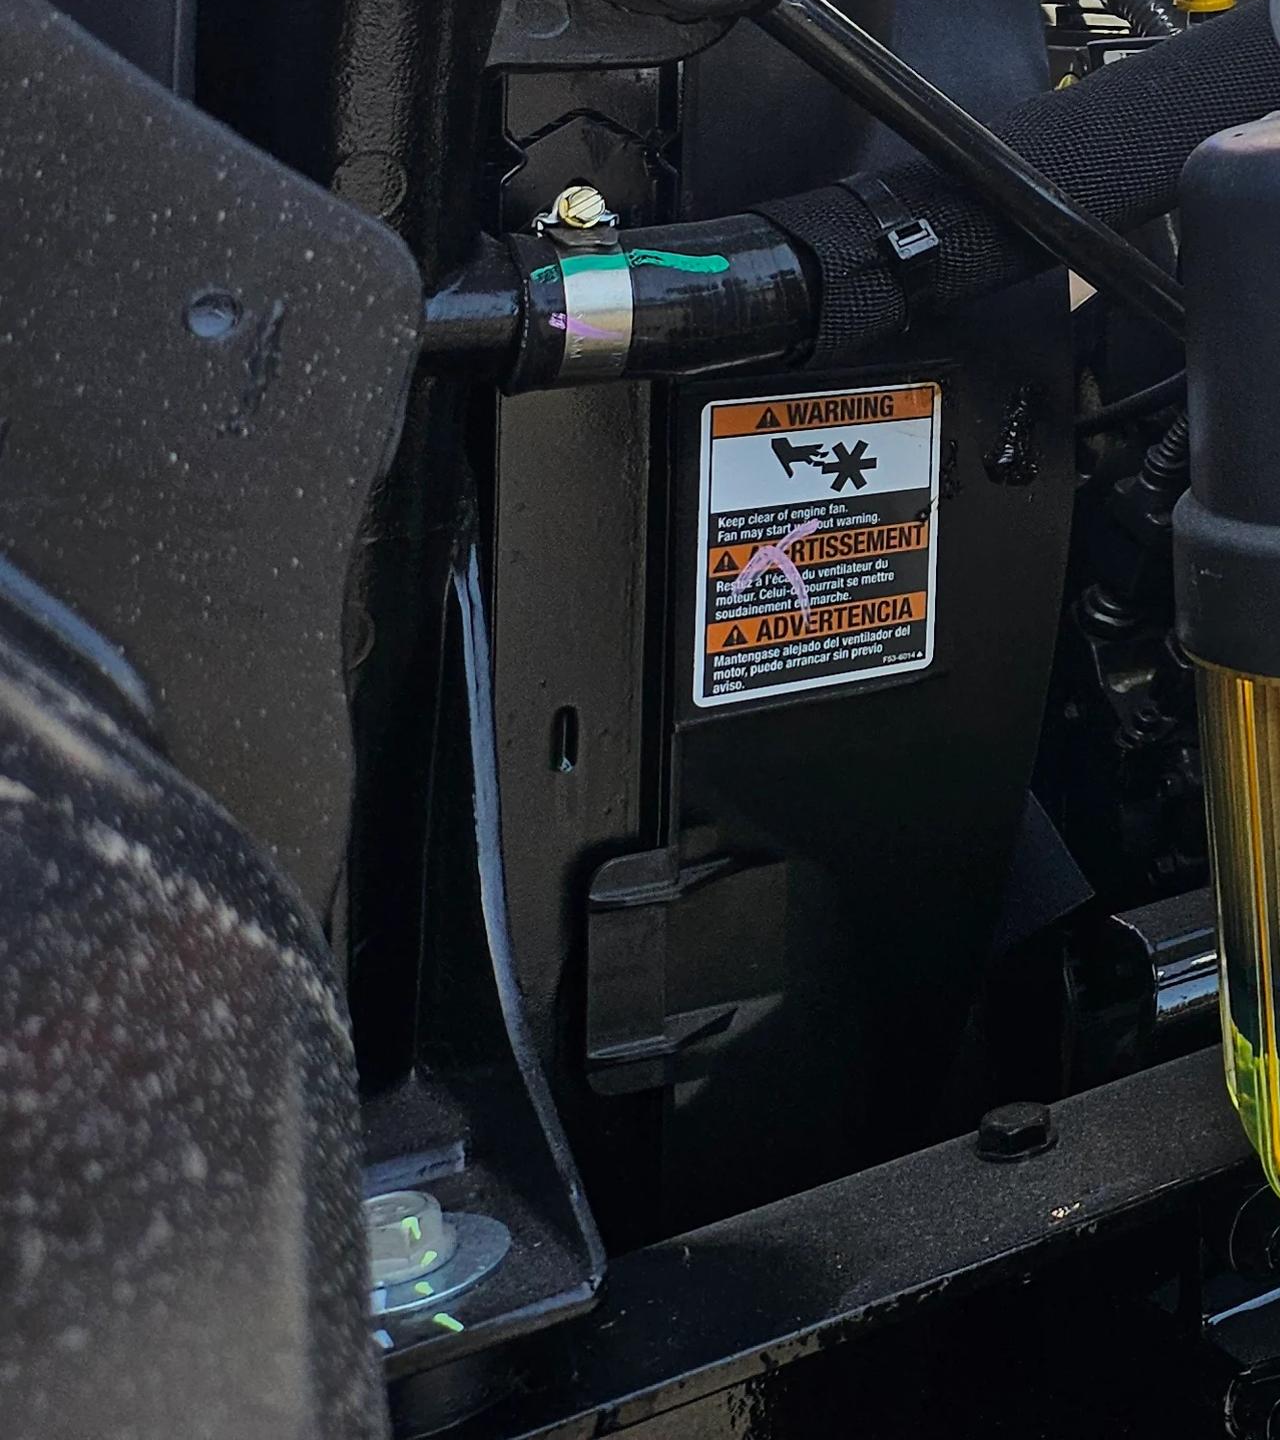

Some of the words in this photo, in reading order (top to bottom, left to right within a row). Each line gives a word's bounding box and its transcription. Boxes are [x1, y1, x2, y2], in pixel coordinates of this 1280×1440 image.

[787, 394, 894, 427] WARNING
[718, 517, 745, 529] Keep
[748, 514, 775, 525] clear
[778, 511, 788, 520] of
[791, 508, 826, 521] engine
[829, 505, 848, 515] fan.
[718, 531, 738, 543] Fan
[741, 528, 763, 539] may
[767, 525, 791, 536] start
[794, 519, 834, 532] wout
[836, 513, 880, 527] warning.
[802, 570, 815, 580] du
[818, 562, 872, 578] ventilateur
[875, 559, 888, 569] du
[716, 593, 757, 606] moteur.
[759, 584, 802, 600] Celui-c
[803, 579, 844, 595] pourrait
[846, 577, 858, 586] se
[861, 572, 894, 584] mettre
[715, 600, 791, 620] soudainement
[810, 592, 851, 606] marche.
[756, 597, 913, 643] ADVERTENCIA
[714, 648, 780, 668] Mantengase
[783, 641, 821, 656] alejado
[823, 638, 839, 649] del
[842, 629, 892, 645] ventilador
[895, 624, 910, 637] del
[714, 667, 747, 681] motor,
[750, 661, 783, 677] puede
[785, 652, 830, 668] arrancar
[833, 649, 849, 660] sin
[851, 643, 882, 658] previo
[713, 681, 745, 694] aviso.
